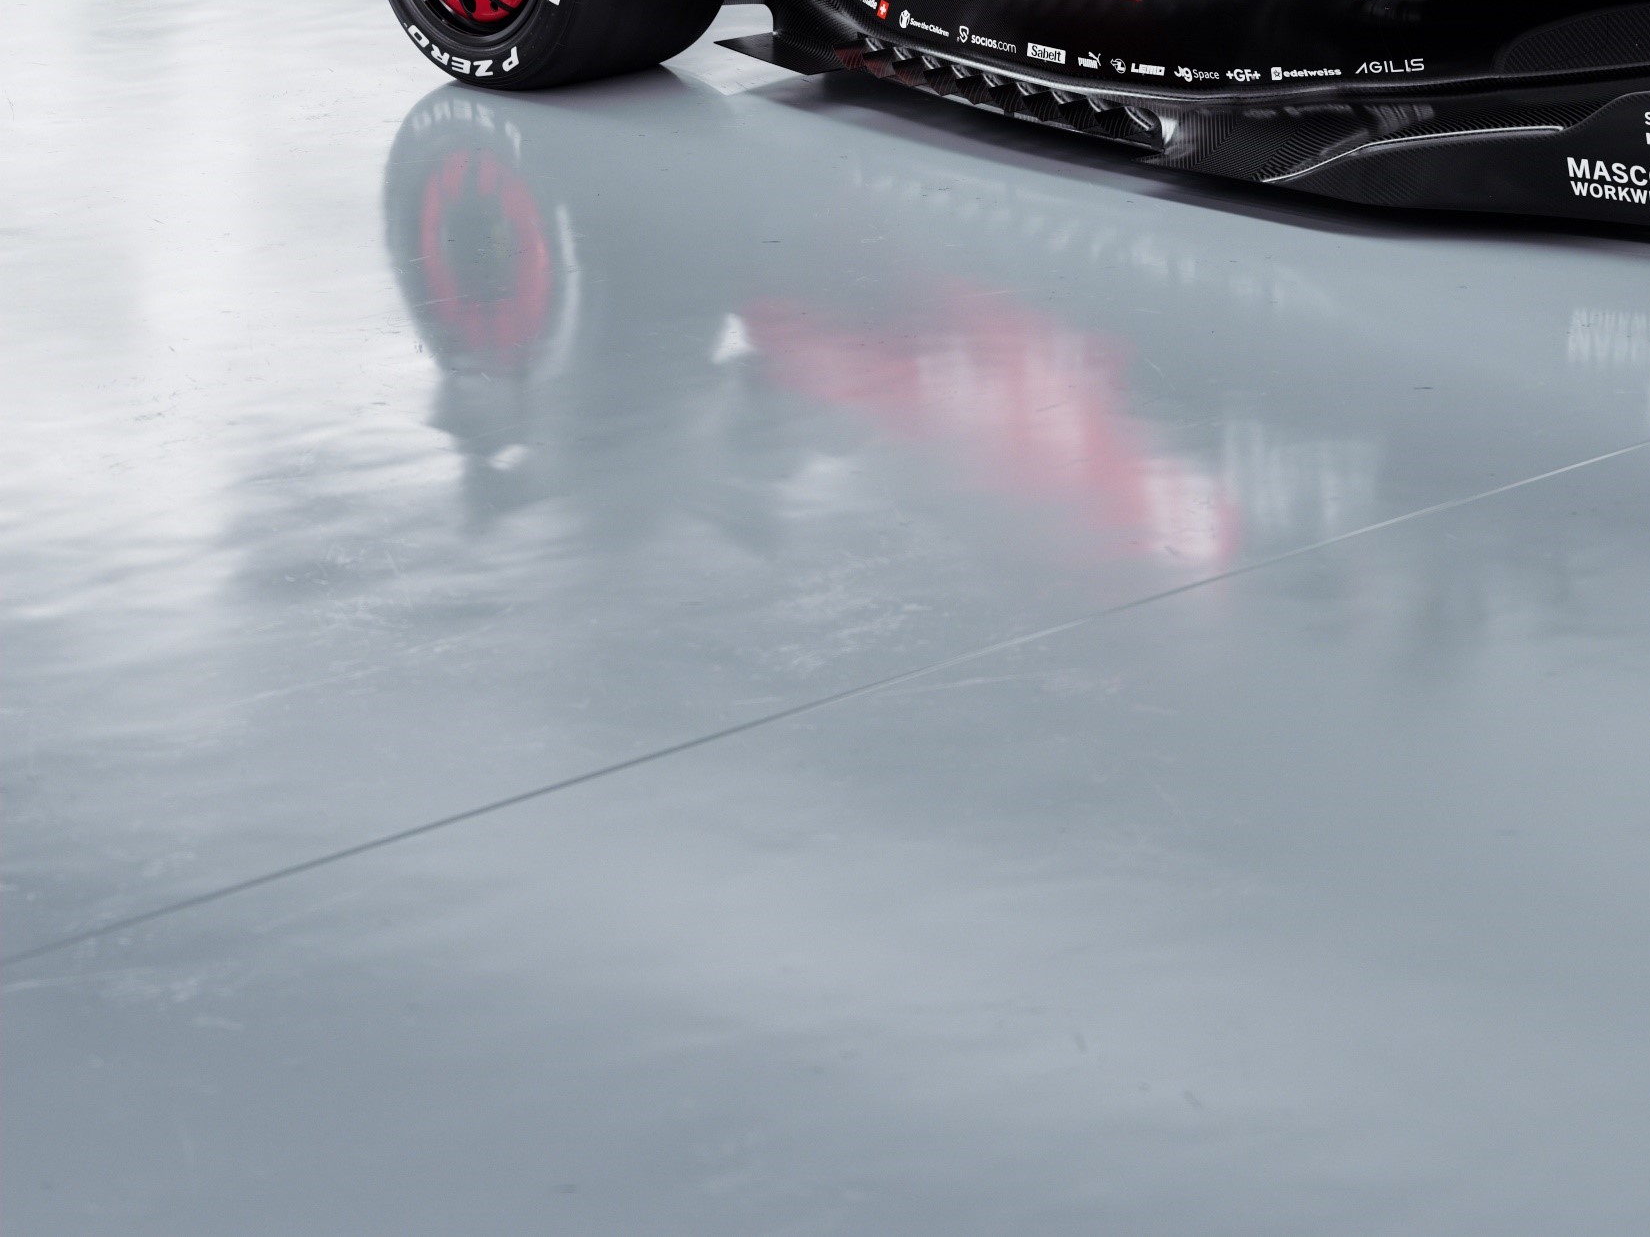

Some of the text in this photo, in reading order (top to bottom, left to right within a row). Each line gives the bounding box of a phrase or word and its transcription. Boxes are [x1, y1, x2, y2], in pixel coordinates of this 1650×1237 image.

[928, 24, 949, 37] Children
[407, 24, 520, 77] P ZERO
[1031, 45, 1062, 61] Sabelt
[1131, 63, 1165, 76] LEMO
[1283, 67, 1342, 78] edelweiss
[1355, 58, 1425, 75] AGILIS
